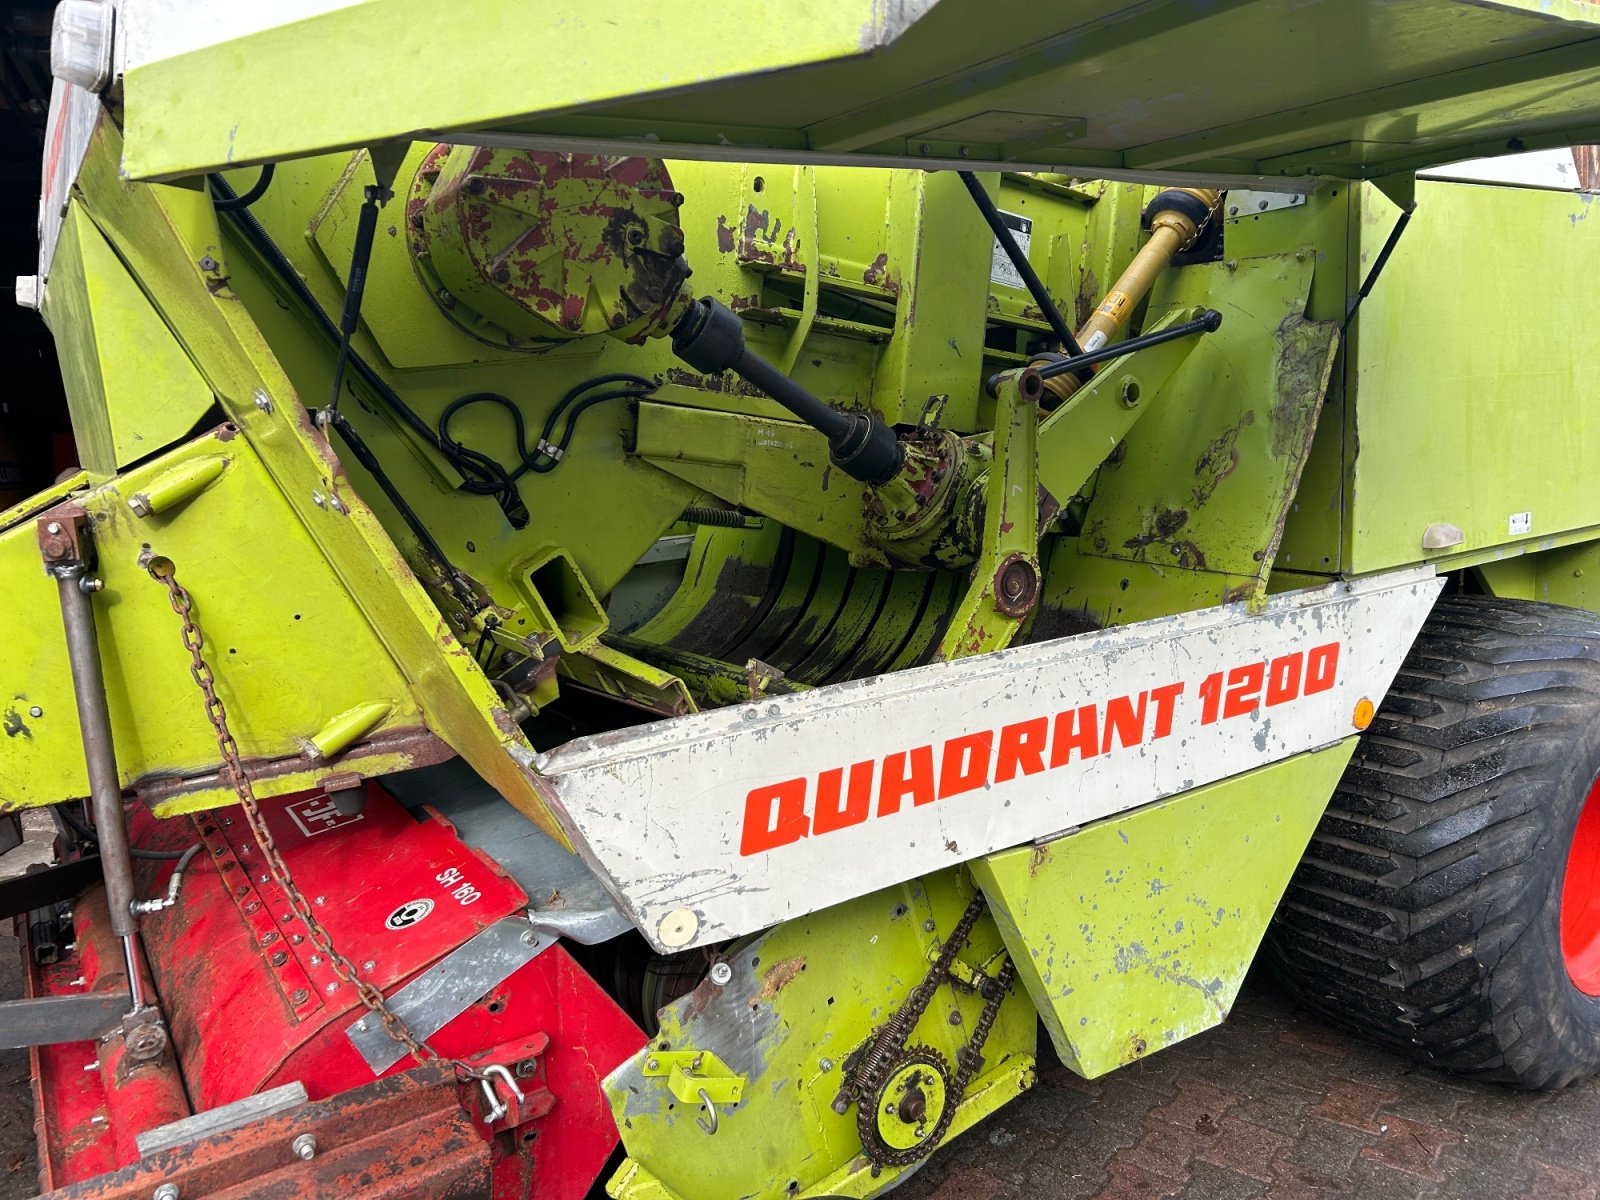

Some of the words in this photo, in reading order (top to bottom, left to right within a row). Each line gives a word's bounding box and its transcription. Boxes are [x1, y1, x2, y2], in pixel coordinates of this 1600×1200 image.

[740, 682, 1185, 856] QUADRANT
[1199, 641, 1340, 726] 1200
[435, 867, 464, 888] SH
[451, 882, 481, 905] 160
